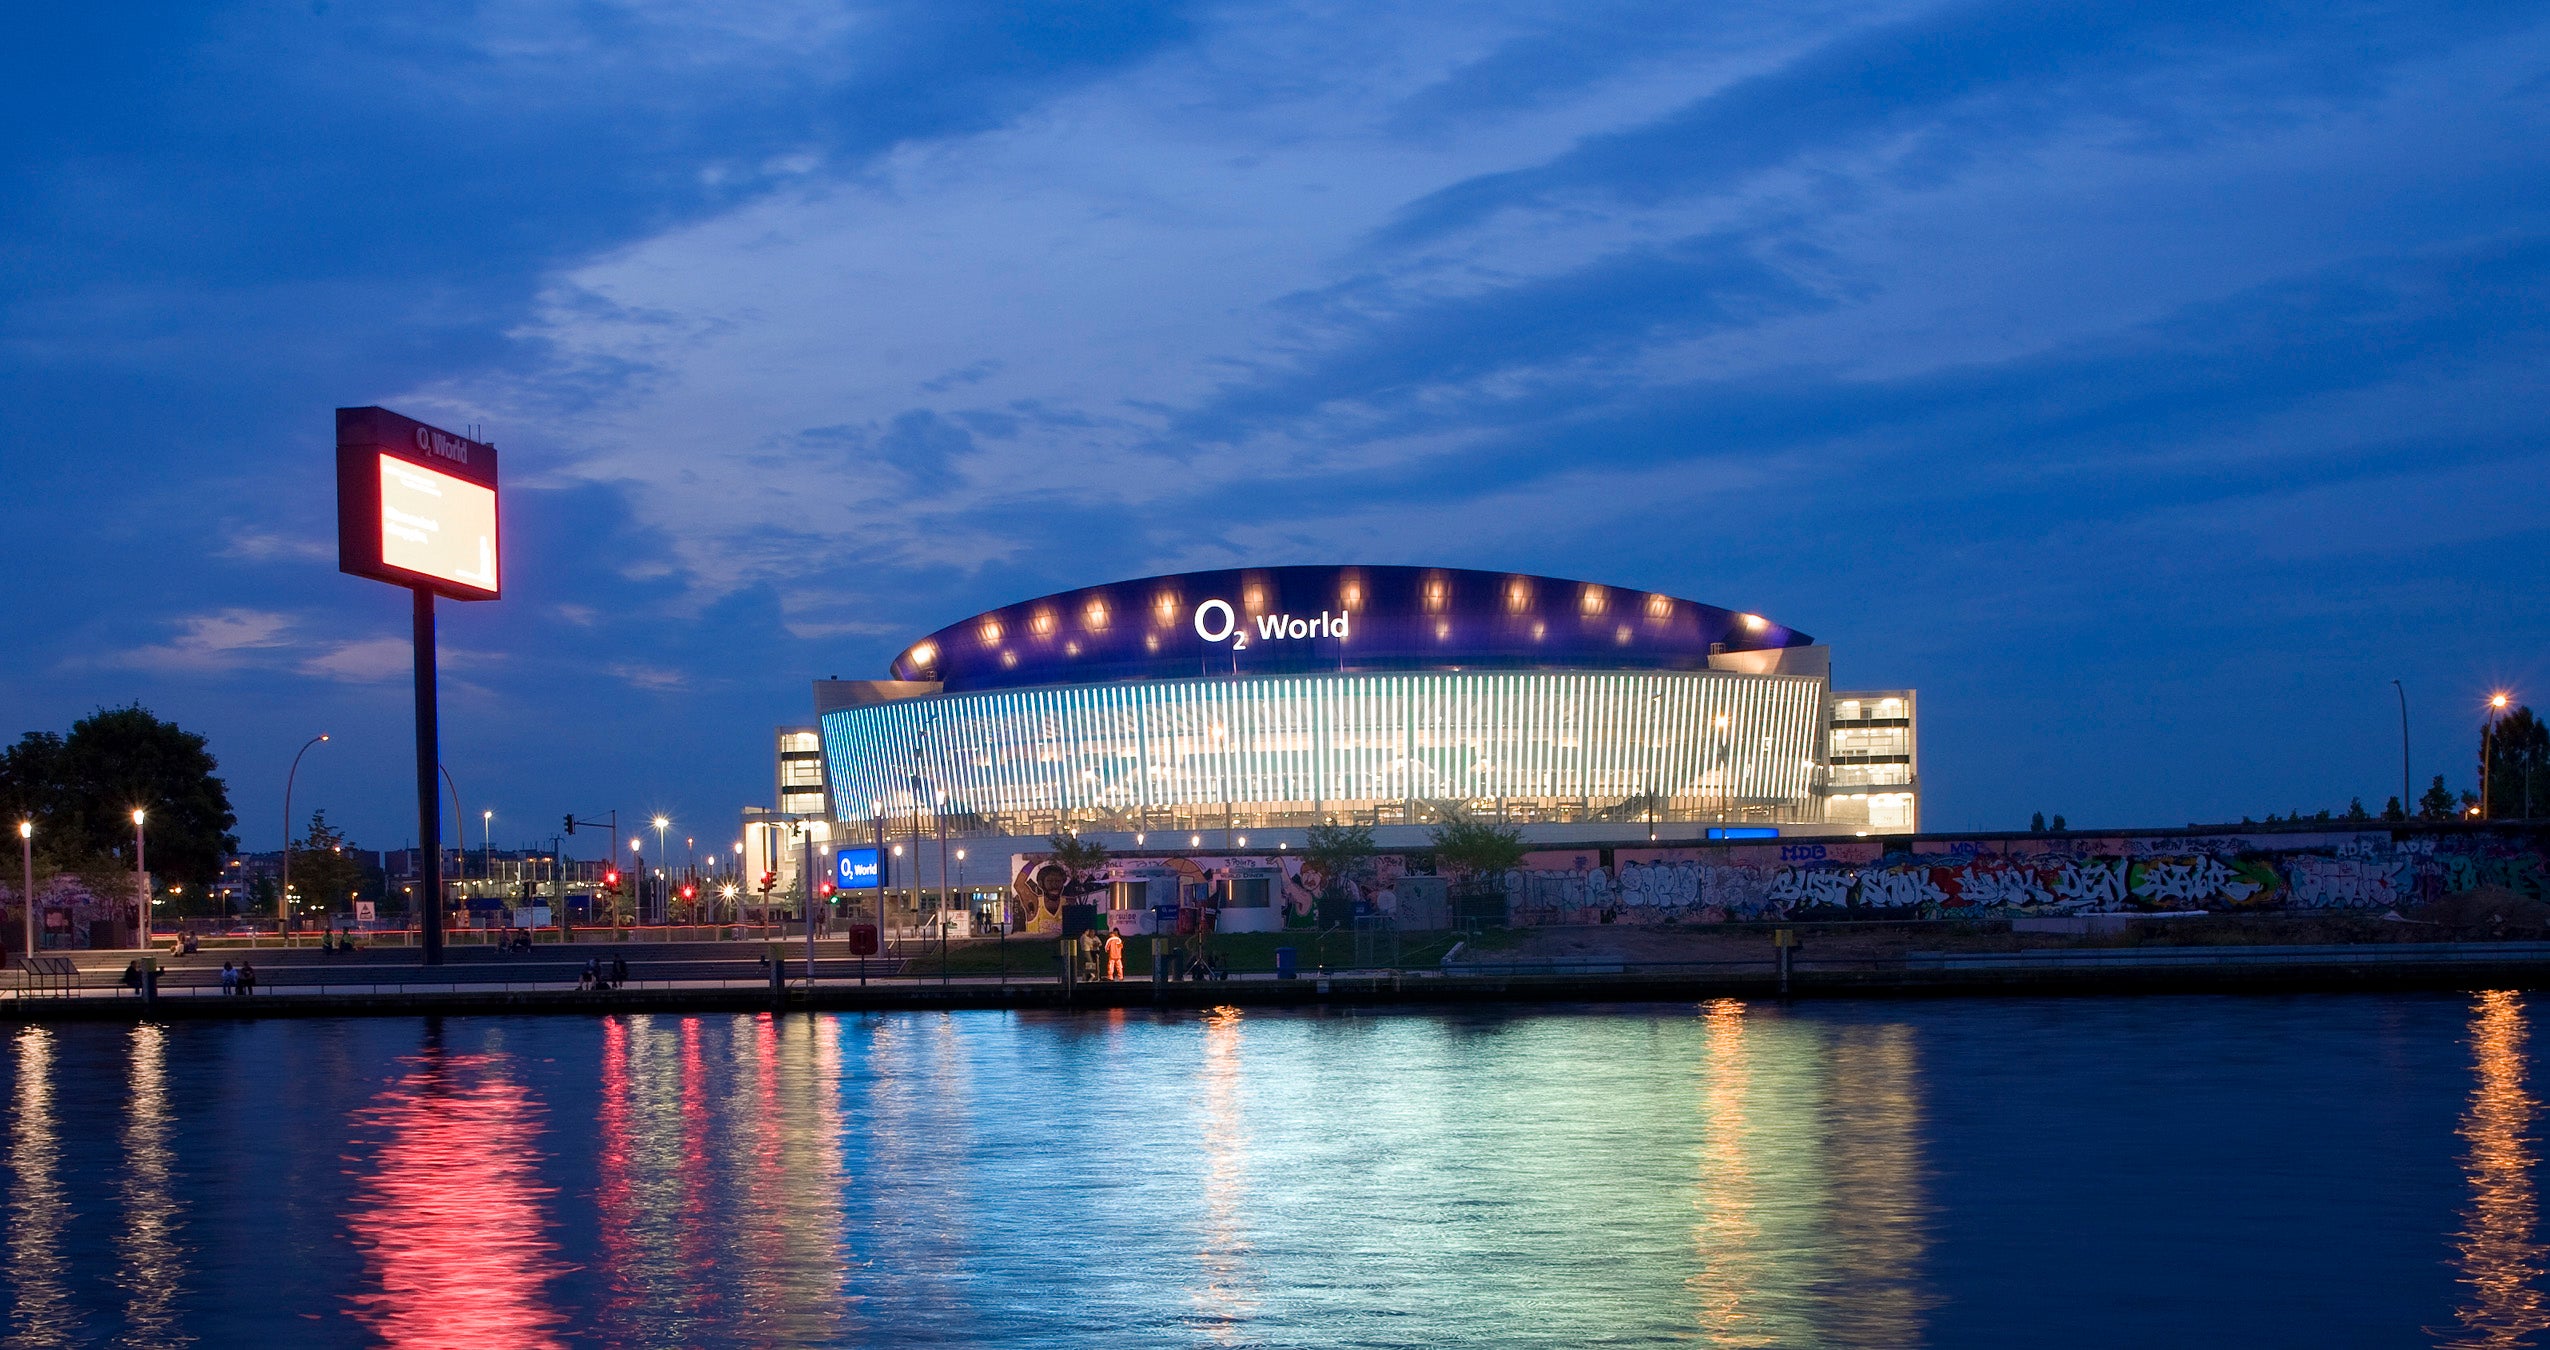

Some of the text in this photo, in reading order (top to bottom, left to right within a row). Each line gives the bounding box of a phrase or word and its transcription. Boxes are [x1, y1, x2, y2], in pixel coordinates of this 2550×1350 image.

[432, 432, 468, 464] World
[1256, 610, 1349, 640] World
[854, 863, 878, 875] World
